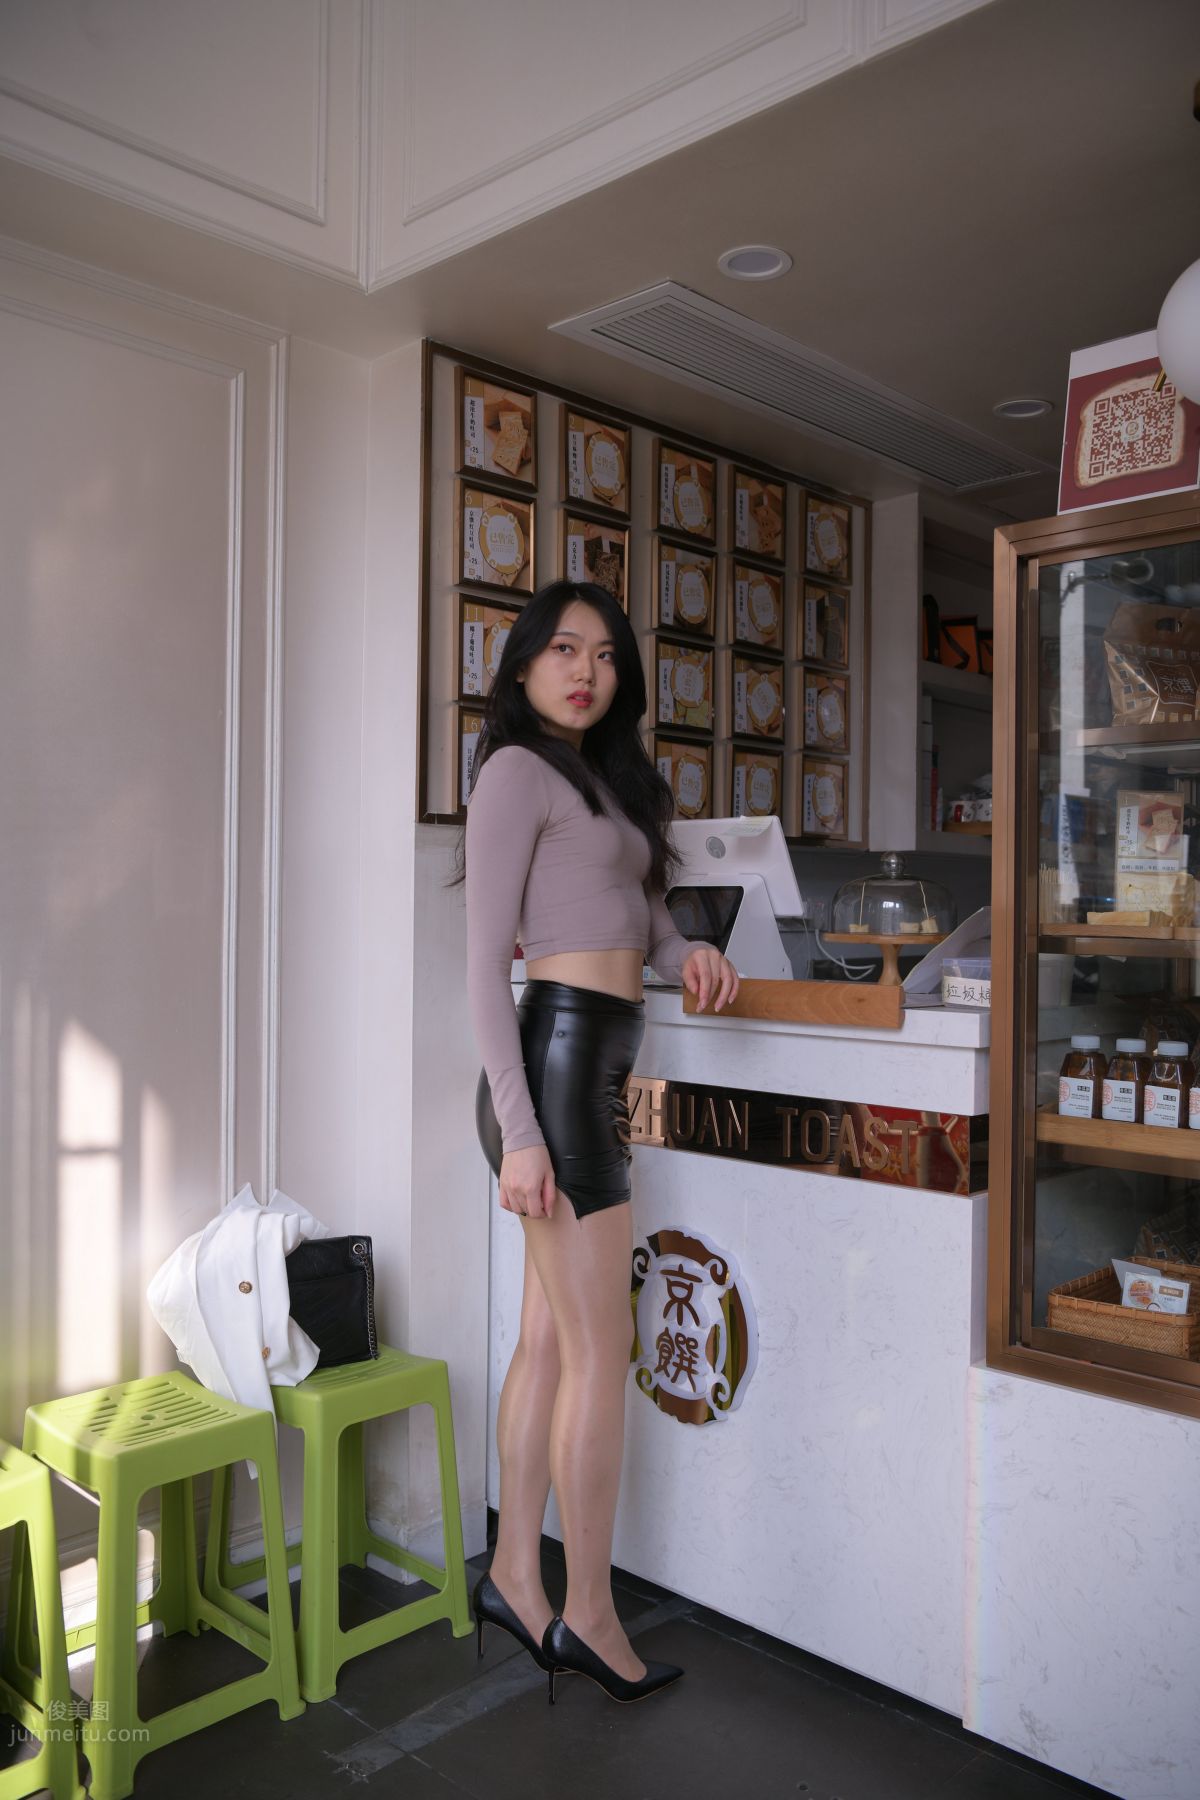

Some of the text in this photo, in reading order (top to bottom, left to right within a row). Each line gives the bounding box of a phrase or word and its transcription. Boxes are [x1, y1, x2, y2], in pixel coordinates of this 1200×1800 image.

[464, 492, 473, 506] 6
[628, 1086, 749, 1152] ZHUAN
[776, 1106, 919, 1175] TOAST
